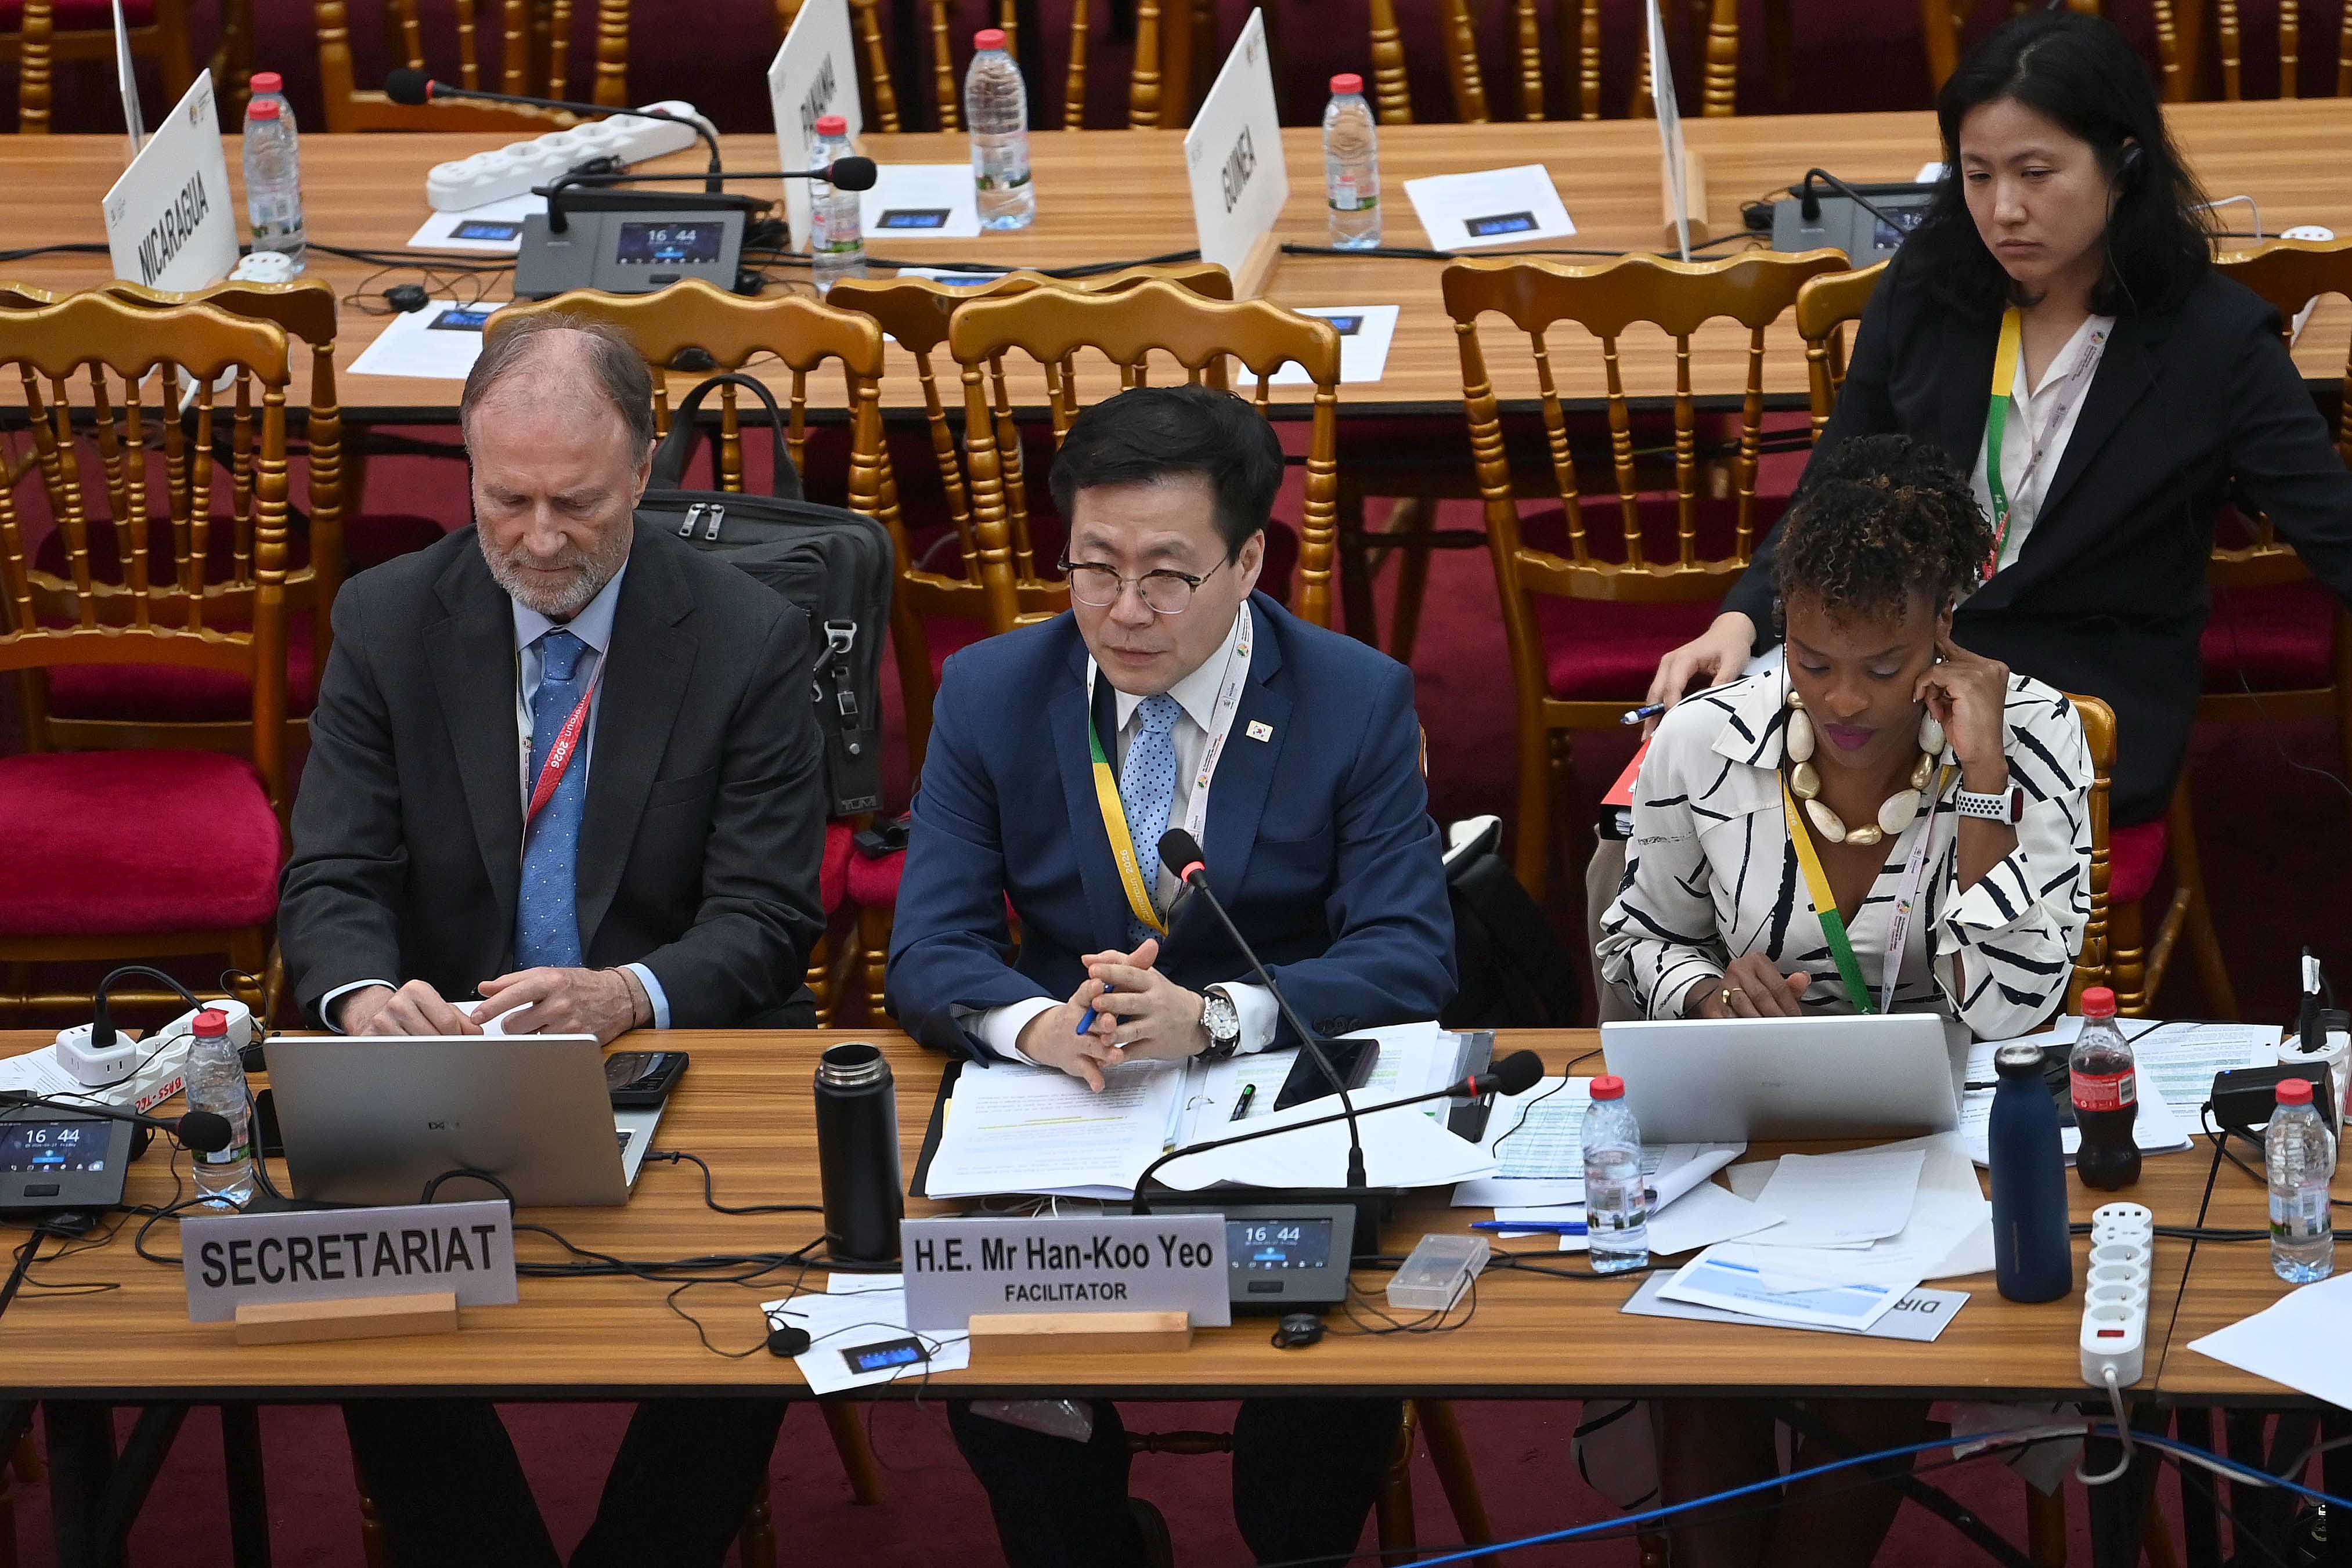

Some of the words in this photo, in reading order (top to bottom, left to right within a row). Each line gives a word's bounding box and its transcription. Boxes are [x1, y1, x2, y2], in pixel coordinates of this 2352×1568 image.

[138, 169, 209, 287] NICARAGUA
[648, 229, 667, 241] 16
[675, 230, 696, 241] 44
[551, 740, 569, 769] 2026
[1120, 849, 1134, 873] 2026
[26, 1129, 46, 1144] 16
[57, 1129, 80, 1143] 44
[1245, 1227, 1267, 1242] 16
[1277, 1227, 1300, 1241] 44
[201, 1224, 496, 1288] SECRETARIAT
[915, 1238, 972, 1273] H.E.
[982, 1237, 1018, 1271] Mr
[1027, 1234, 1150, 1271] Han-Koo
[1157, 1234, 1214, 1269] Yeo
[1005, 1282, 1128, 1302] FACILITATOR
